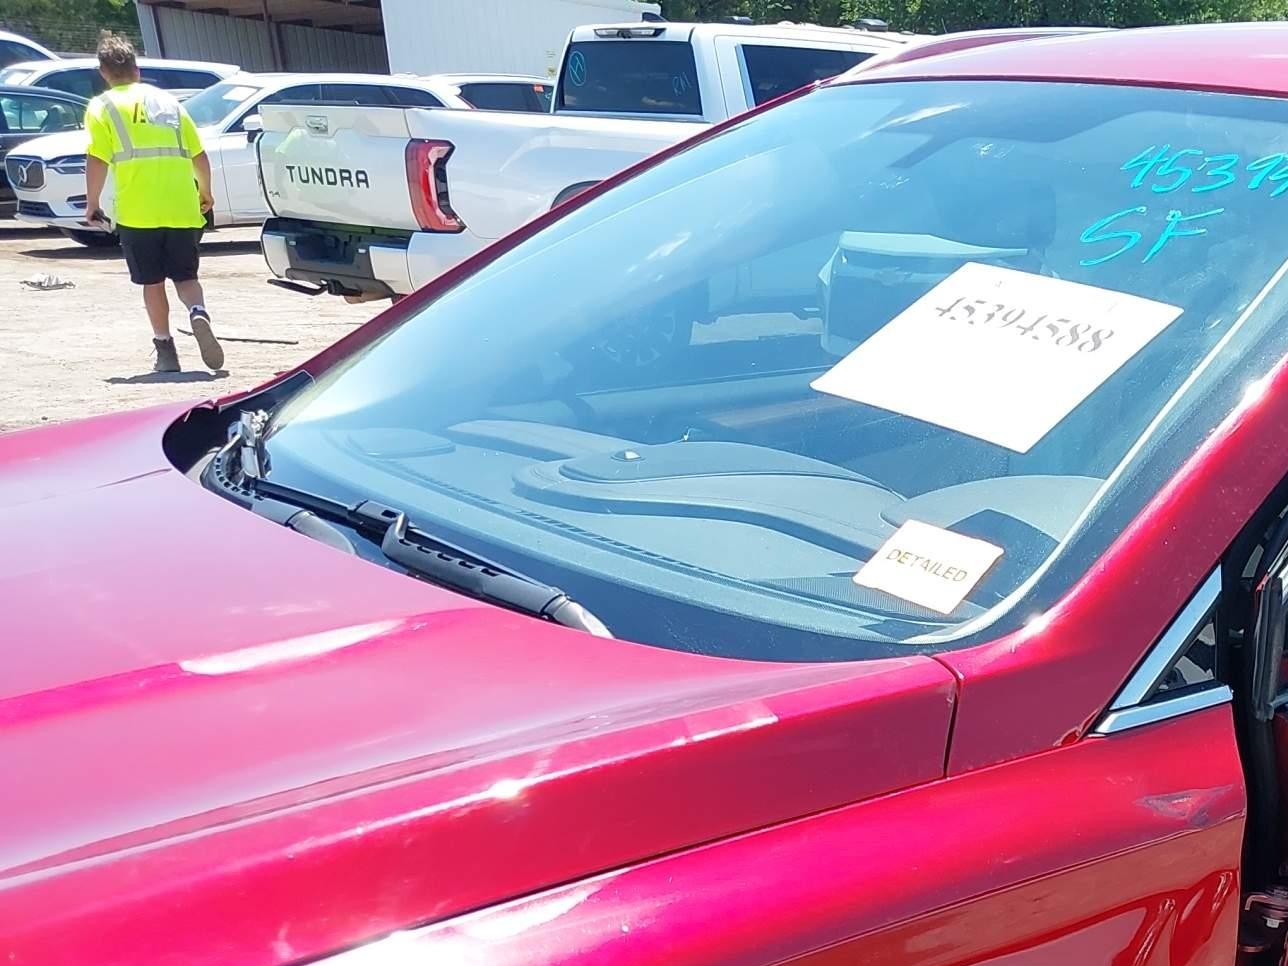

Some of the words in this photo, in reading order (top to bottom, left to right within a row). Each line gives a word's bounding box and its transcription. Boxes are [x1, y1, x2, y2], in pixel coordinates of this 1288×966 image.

[285, 165, 370, 189] TUNDRA
[1079, 206, 1225, 266] SF
[935, 296, 1115, 353] 45394588
[885, 547, 968, 582] DETAILED
